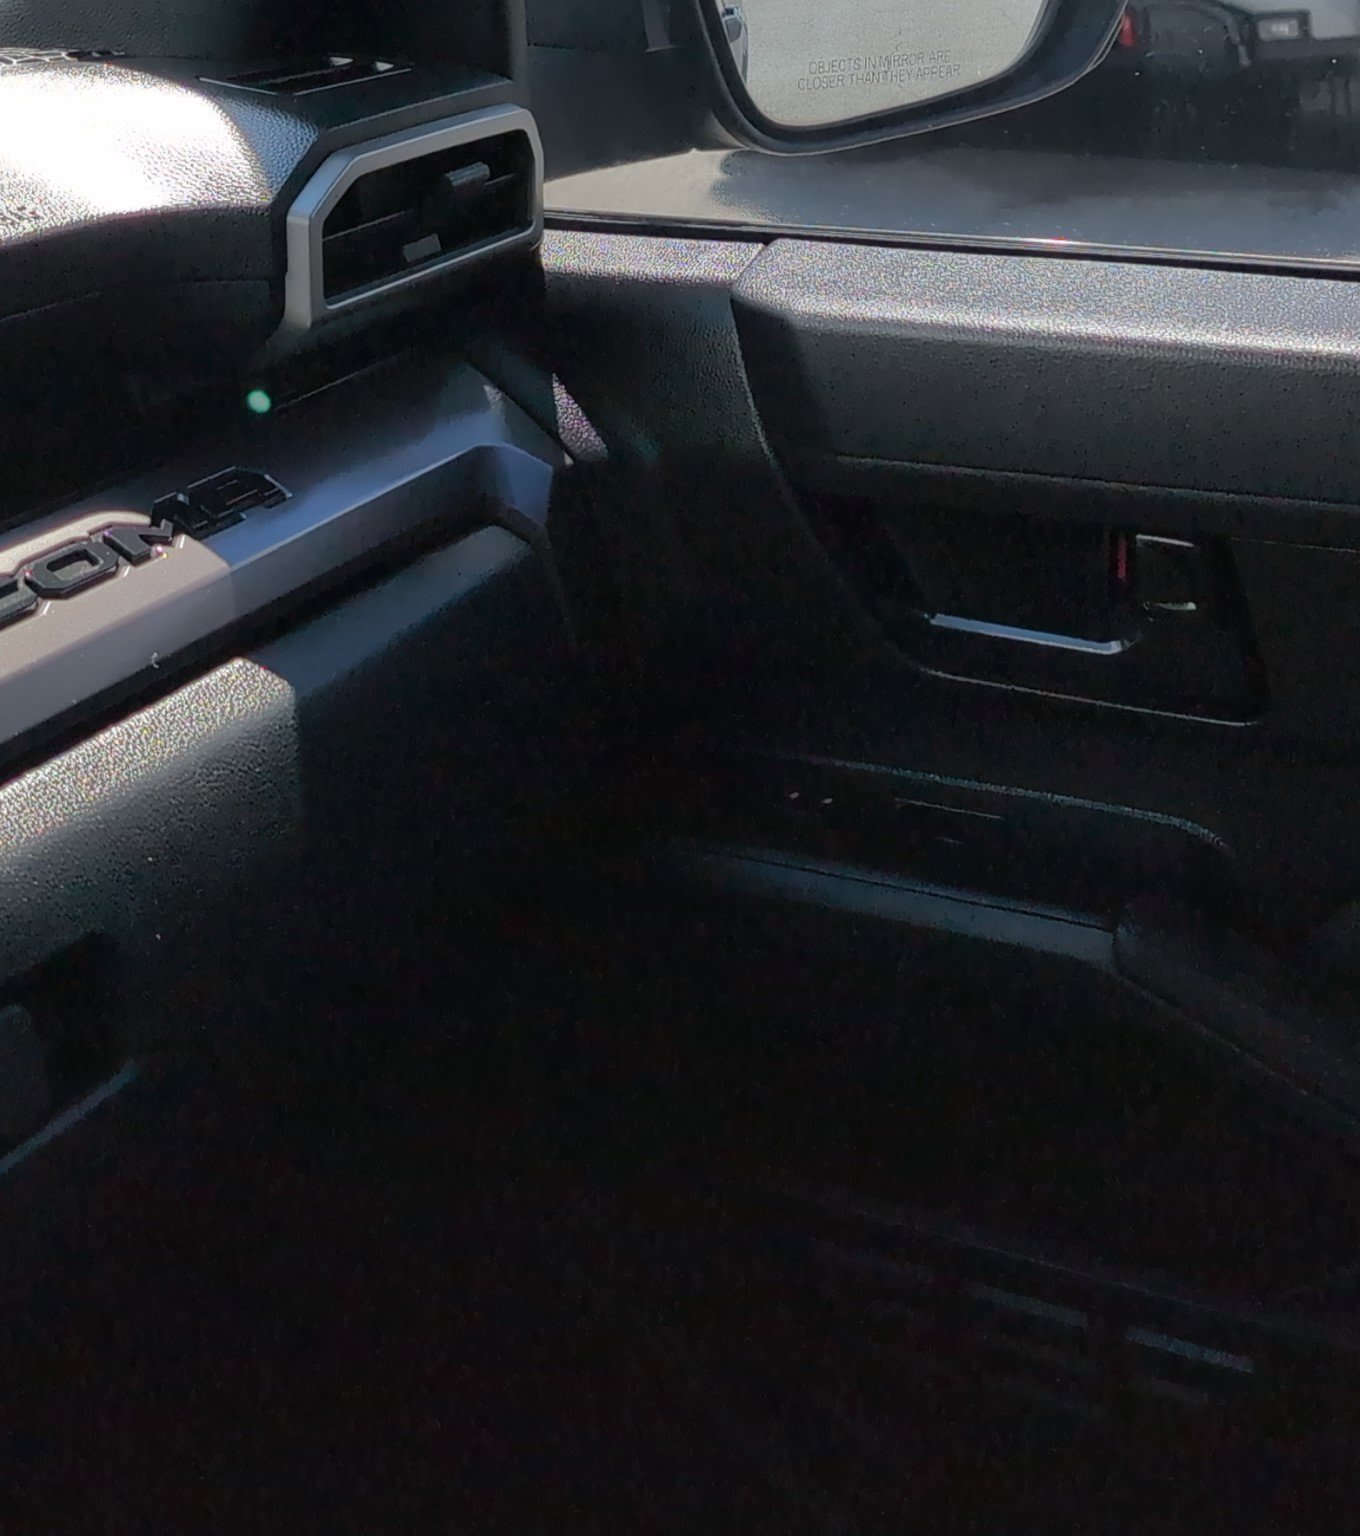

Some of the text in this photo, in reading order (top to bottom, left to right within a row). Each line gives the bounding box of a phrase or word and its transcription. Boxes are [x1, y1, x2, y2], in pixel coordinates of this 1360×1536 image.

[809, 49, 952, 76] OBJECTS IN MIRROR ARE
[797, 64, 962, 92] CLOSER THAN THEY APPEAR
